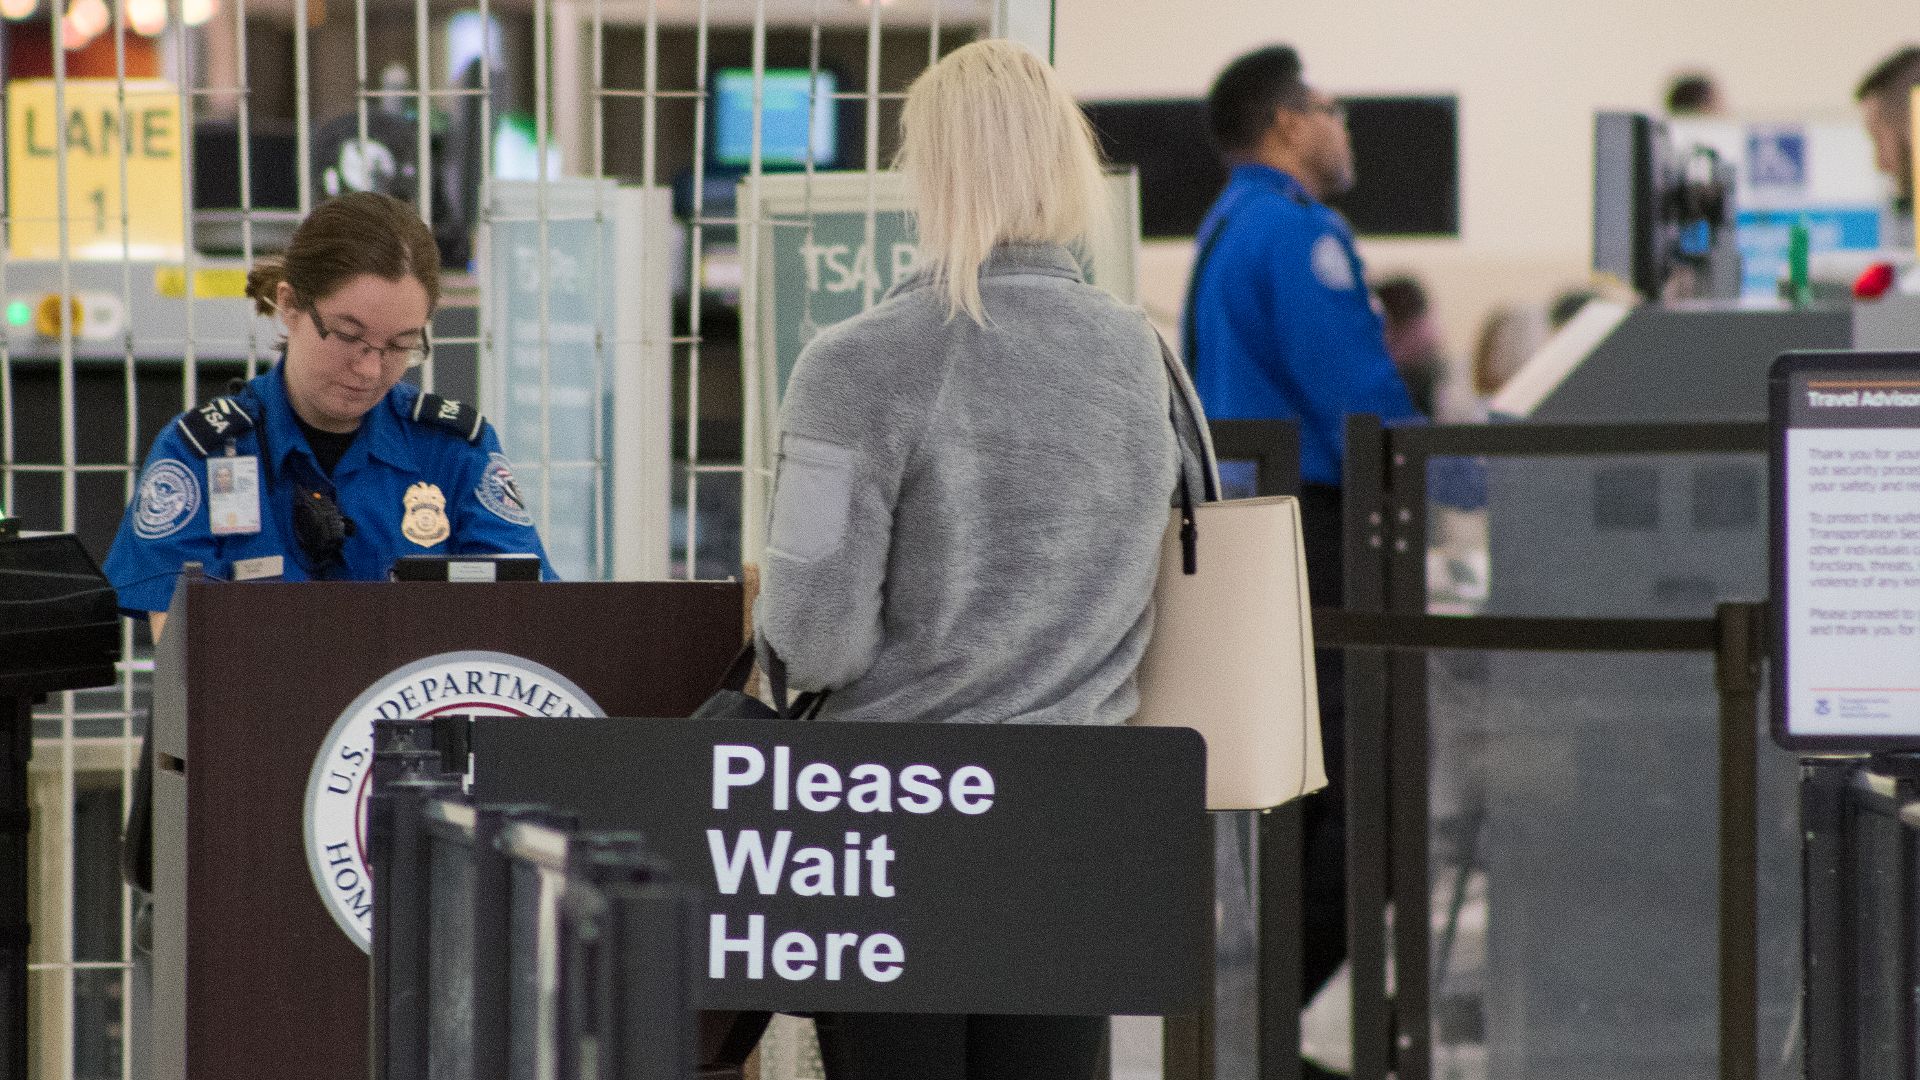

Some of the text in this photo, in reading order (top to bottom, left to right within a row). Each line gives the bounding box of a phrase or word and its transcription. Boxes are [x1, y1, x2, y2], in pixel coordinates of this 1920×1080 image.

[25, 110, 173, 159] LANE
[90, 188, 106, 234] 1
[800, 244, 881, 292] TSA
[199, 402, 231, 434] TSA
[438, 399, 461, 419] TSA
[1807, 390, 1858, 408] Travel
[1808, 447, 1844, 460] Thank
[327, 744, 370, 796] U.S.
[711, 744, 995, 815] Please
[706, 829, 896, 898] Wait
[708, 914, 906, 983] Here
